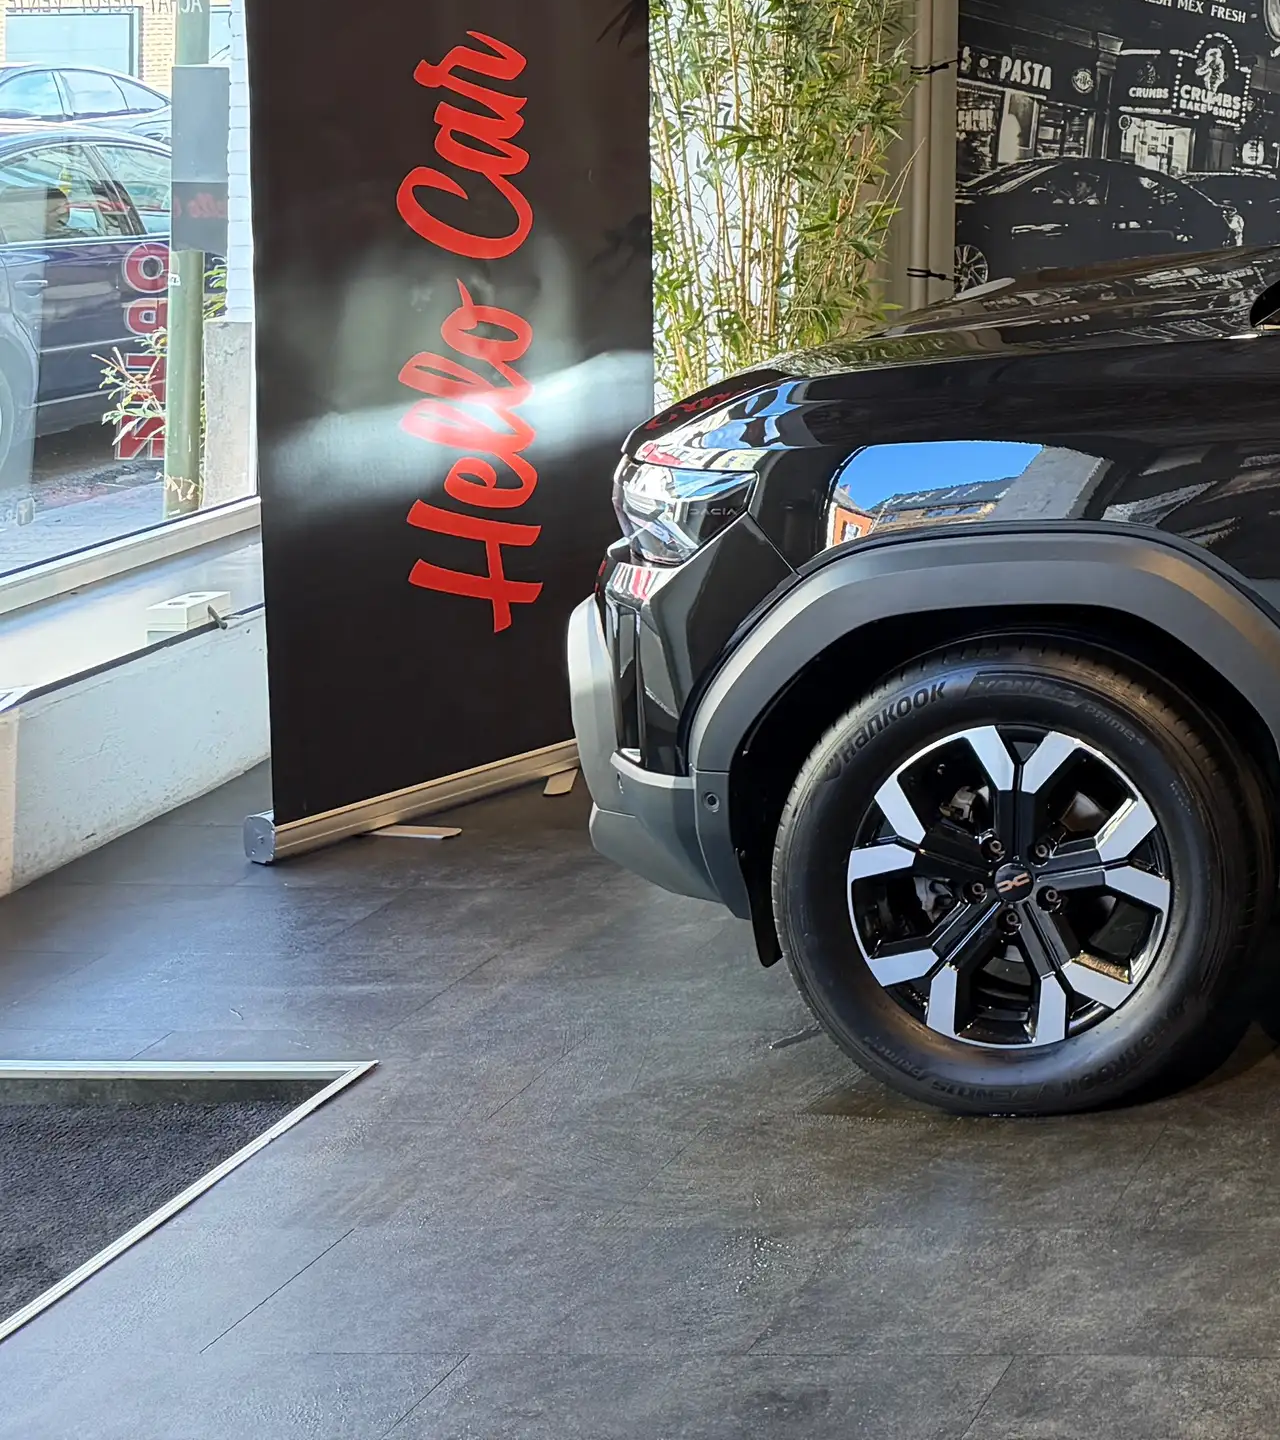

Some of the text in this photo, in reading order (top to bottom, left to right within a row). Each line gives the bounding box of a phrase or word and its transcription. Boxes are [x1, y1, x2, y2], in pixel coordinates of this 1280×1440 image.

[1211, 5, 1247, 24] FRESH
[999, 56, 1052, 90] PASTA
[1129, 86, 1170, 100] CRUMBS
[396, 31, 543, 632] Hello Car
[689, 508, 739, 516] DACIA
